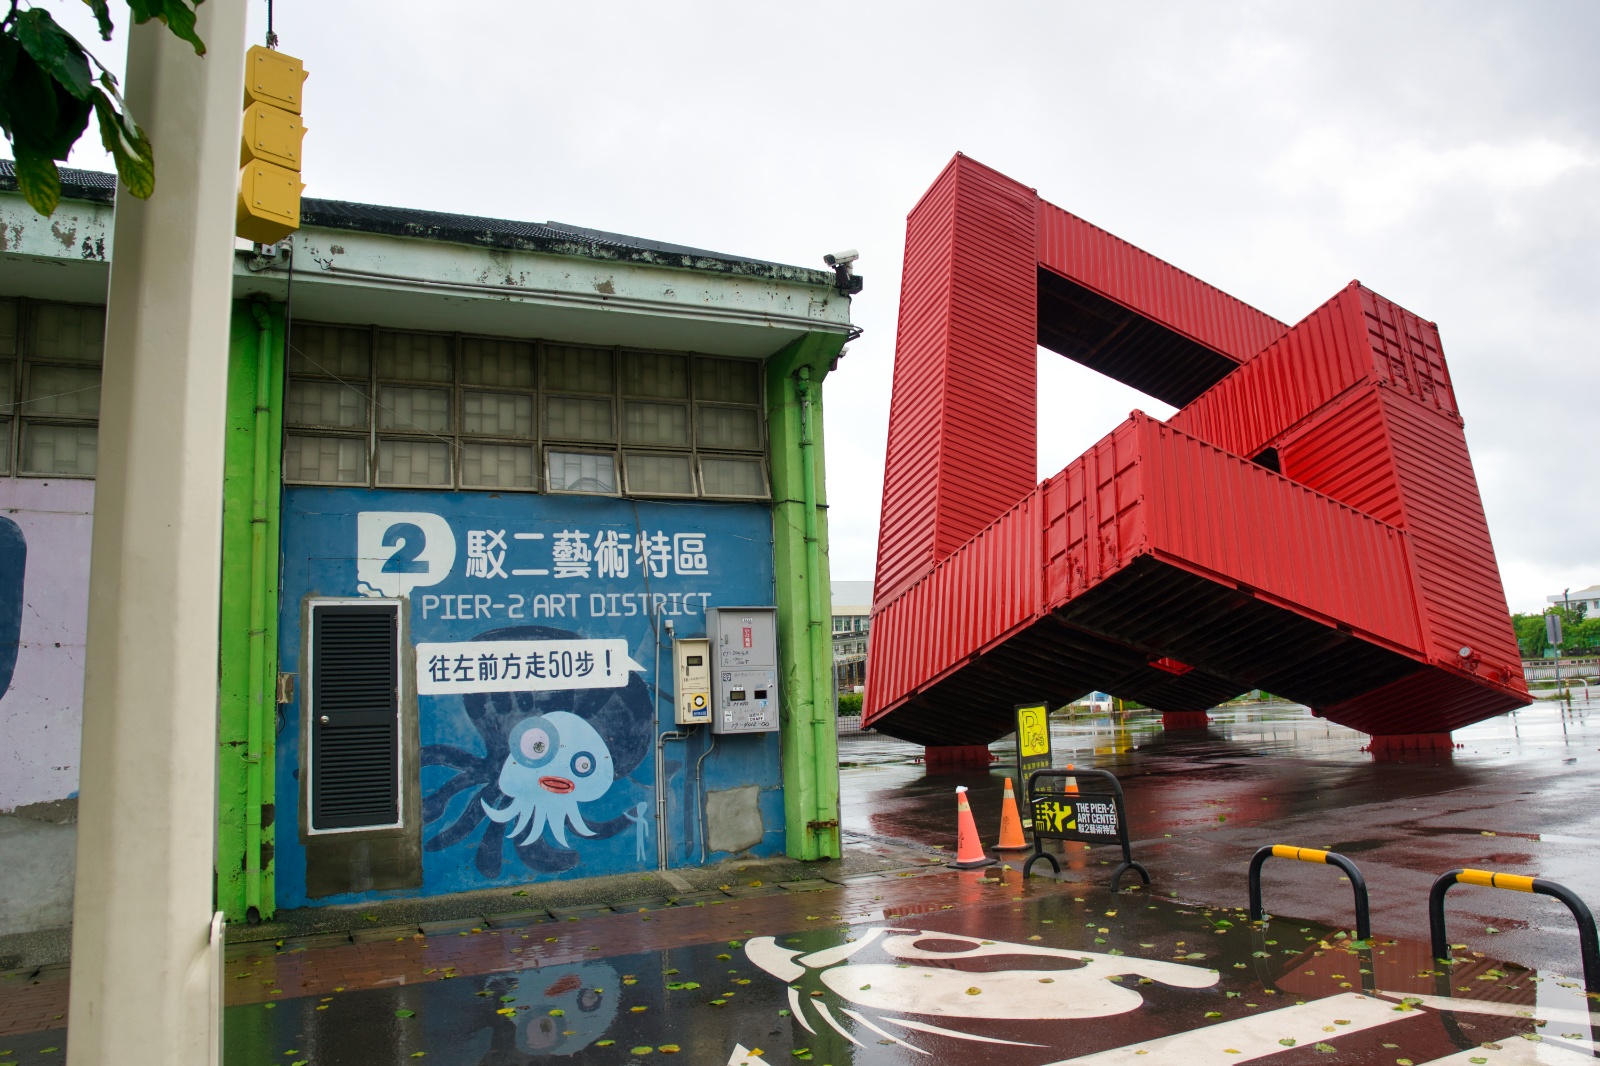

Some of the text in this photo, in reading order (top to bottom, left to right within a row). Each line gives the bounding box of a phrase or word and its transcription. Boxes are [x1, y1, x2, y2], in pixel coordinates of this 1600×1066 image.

[466, 529, 709, 579] 駁二藝術特區
[422, 592, 712, 620] PIER-2 ART DISTRICT
[1076, 802, 1115, 814] THE PIER-2
[1077, 813, 1091, 823] ART
